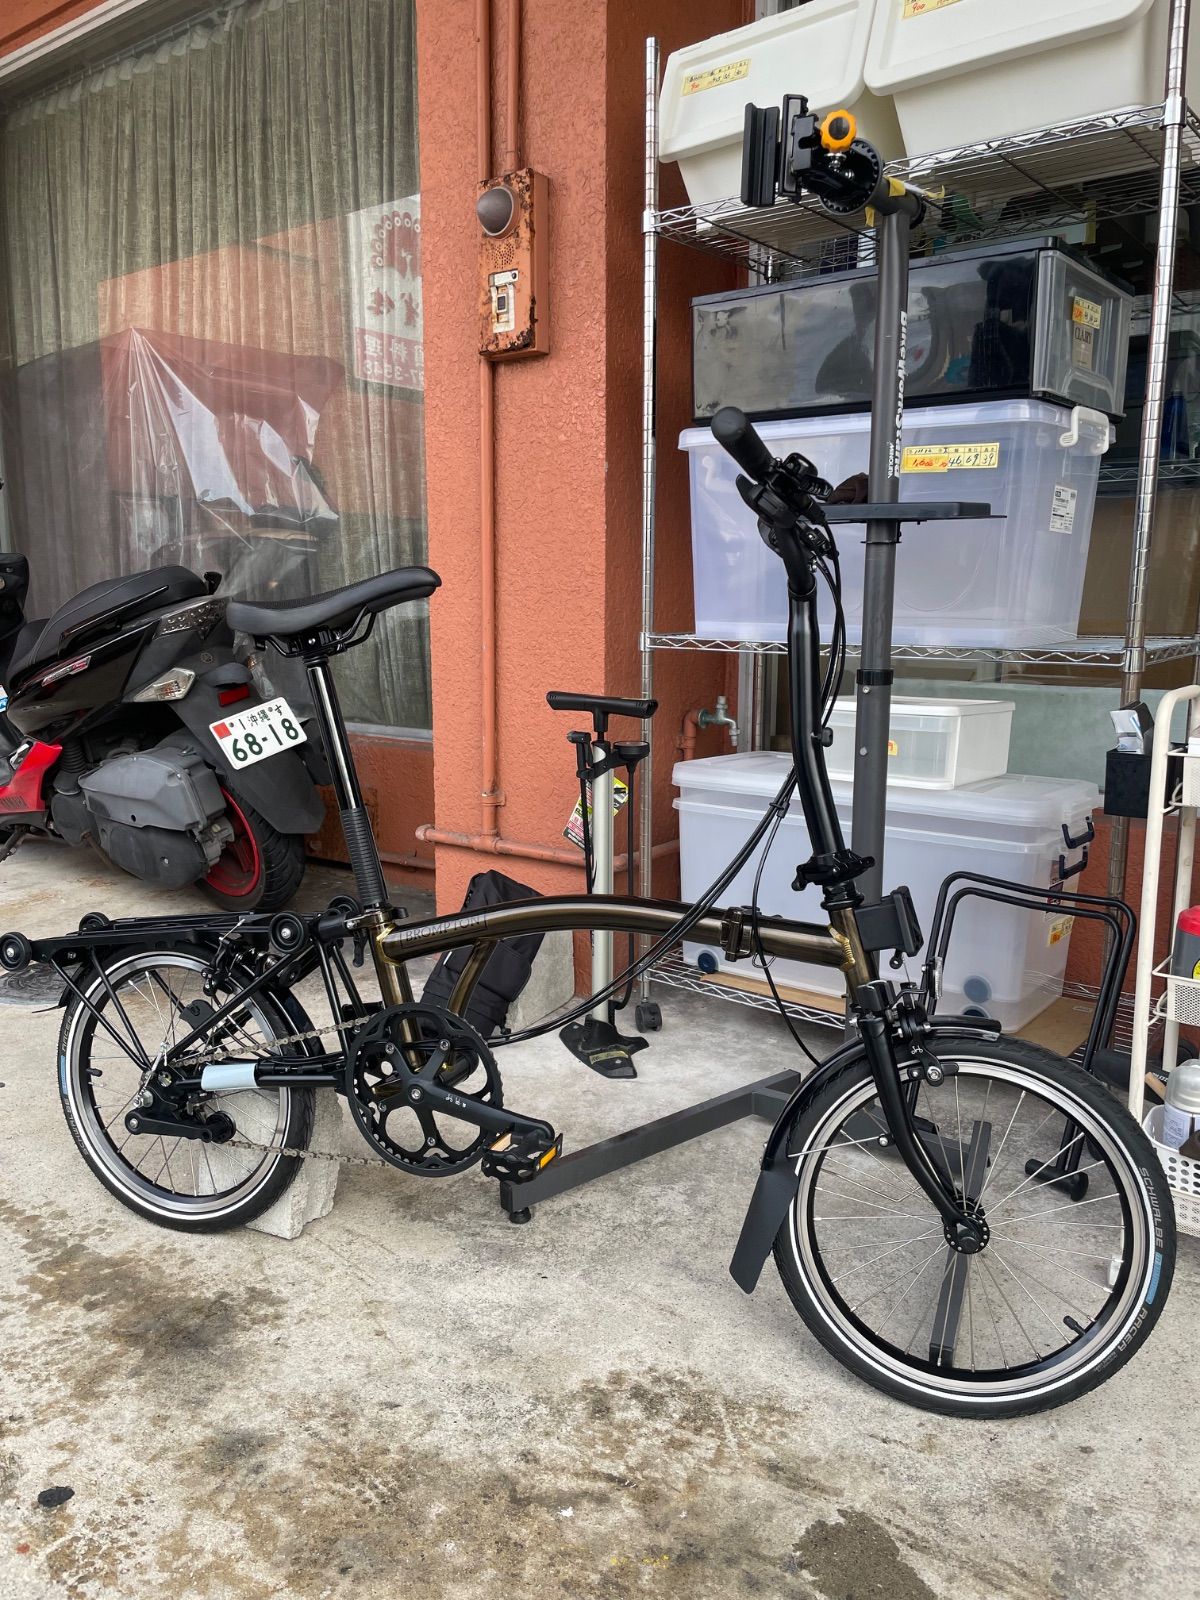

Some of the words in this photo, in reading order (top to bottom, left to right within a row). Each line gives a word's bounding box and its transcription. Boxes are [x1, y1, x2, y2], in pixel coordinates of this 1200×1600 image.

[231, 717, 300, 762] 68-18
[405, 915, 481, 942] BROMPTON
[1139, 1166, 1164, 1249] SCHWALBE
[1117, 1307, 1148, 1352] RACER
